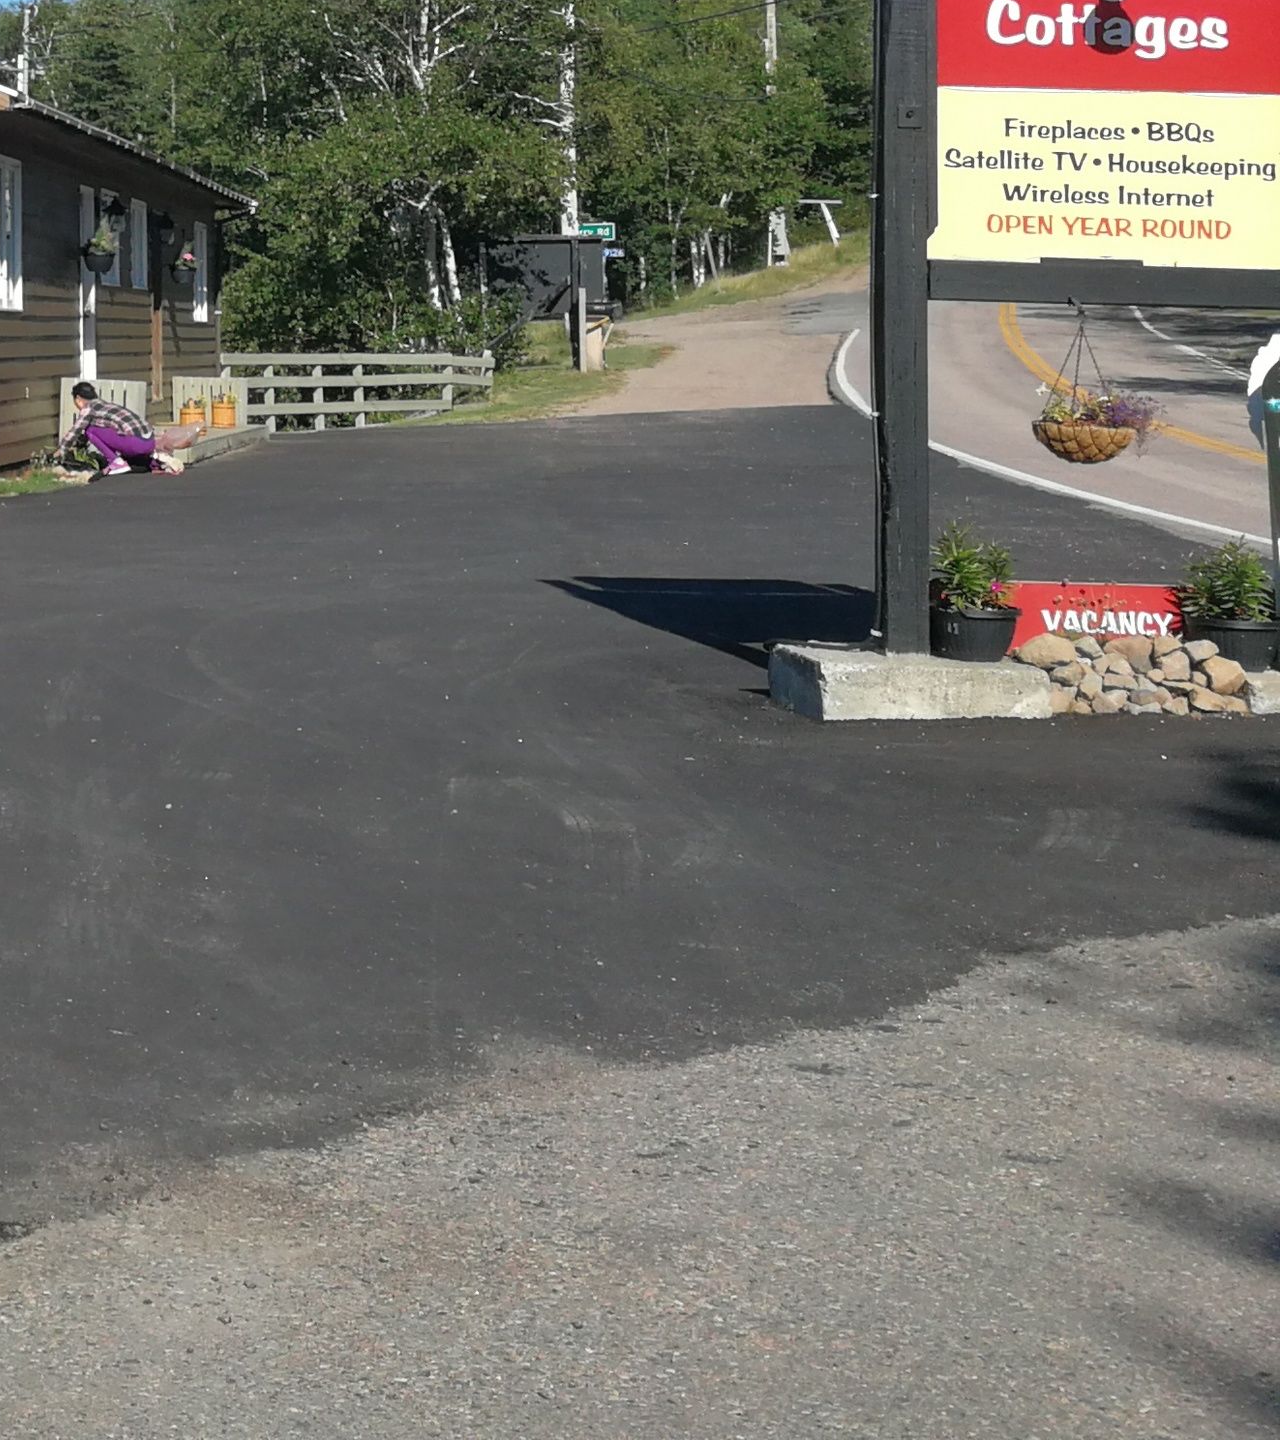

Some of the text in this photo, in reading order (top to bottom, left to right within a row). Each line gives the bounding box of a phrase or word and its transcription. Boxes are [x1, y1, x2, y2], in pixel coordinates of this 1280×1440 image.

[1003, 117, 1215, 143] Fireplaces BBQs
[943, 147, 1276, 181] Satellite TV Housekeeping
[1002, 183, 1215, 207] Wireless Internet
[986, 213, 1232, 240] OPEN YEAR ROUND
[1041, 609, 1174, 636] VACANCY
